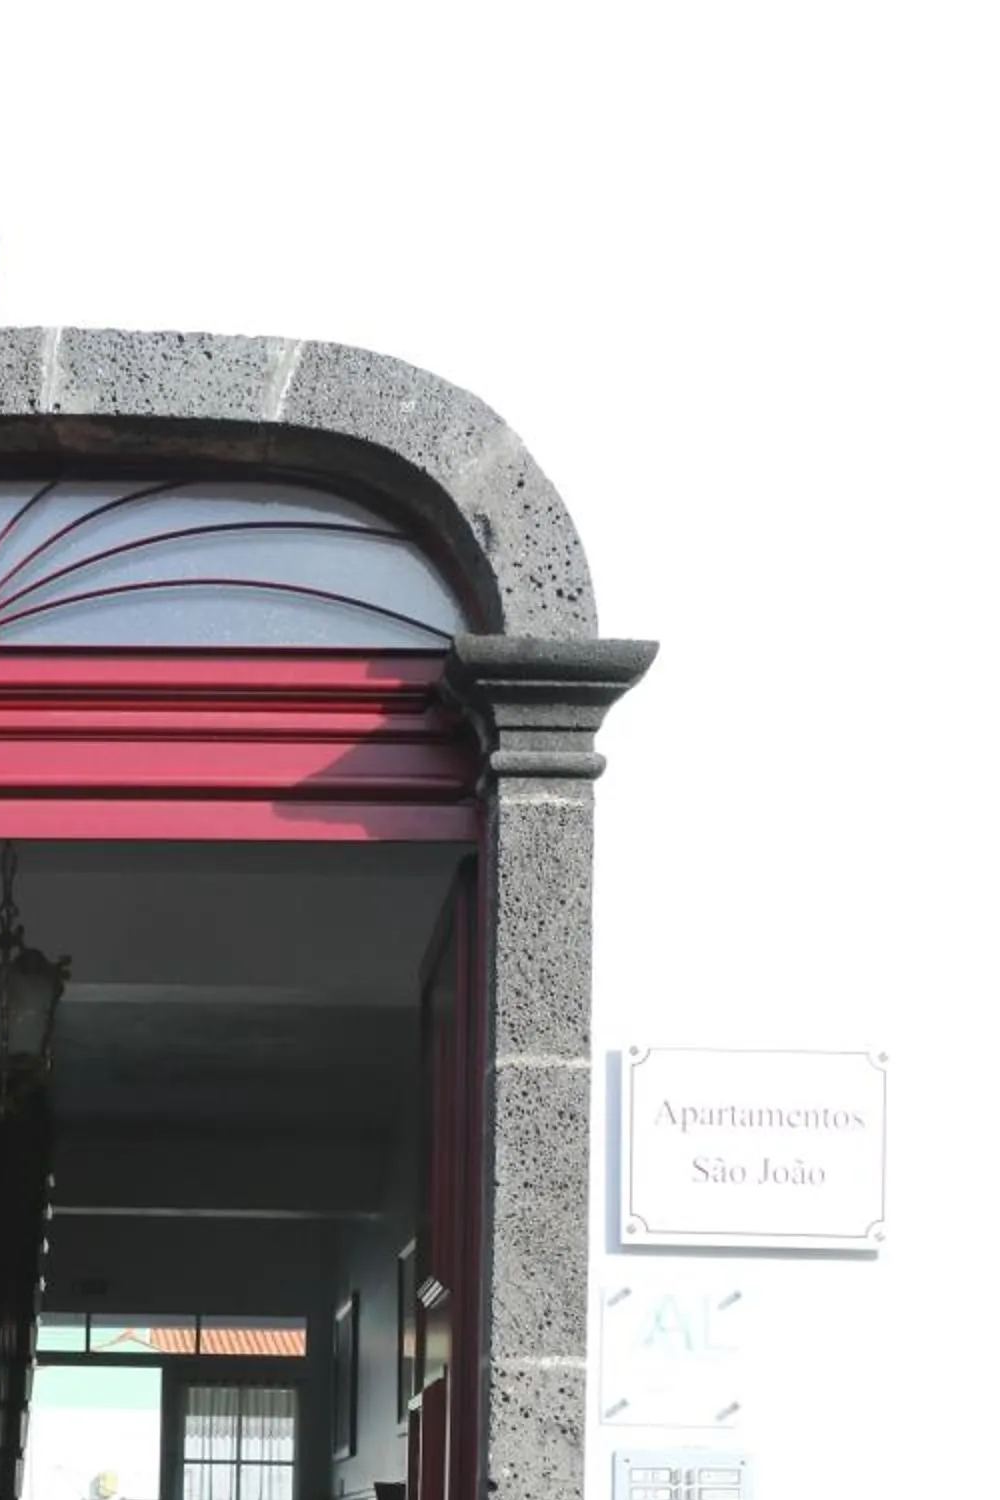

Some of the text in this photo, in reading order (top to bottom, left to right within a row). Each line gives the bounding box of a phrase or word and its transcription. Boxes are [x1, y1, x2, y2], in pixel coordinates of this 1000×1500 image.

[653, 1099, 866, 1133] Apartamentos
[692, 1155, 826, 1186] São João
